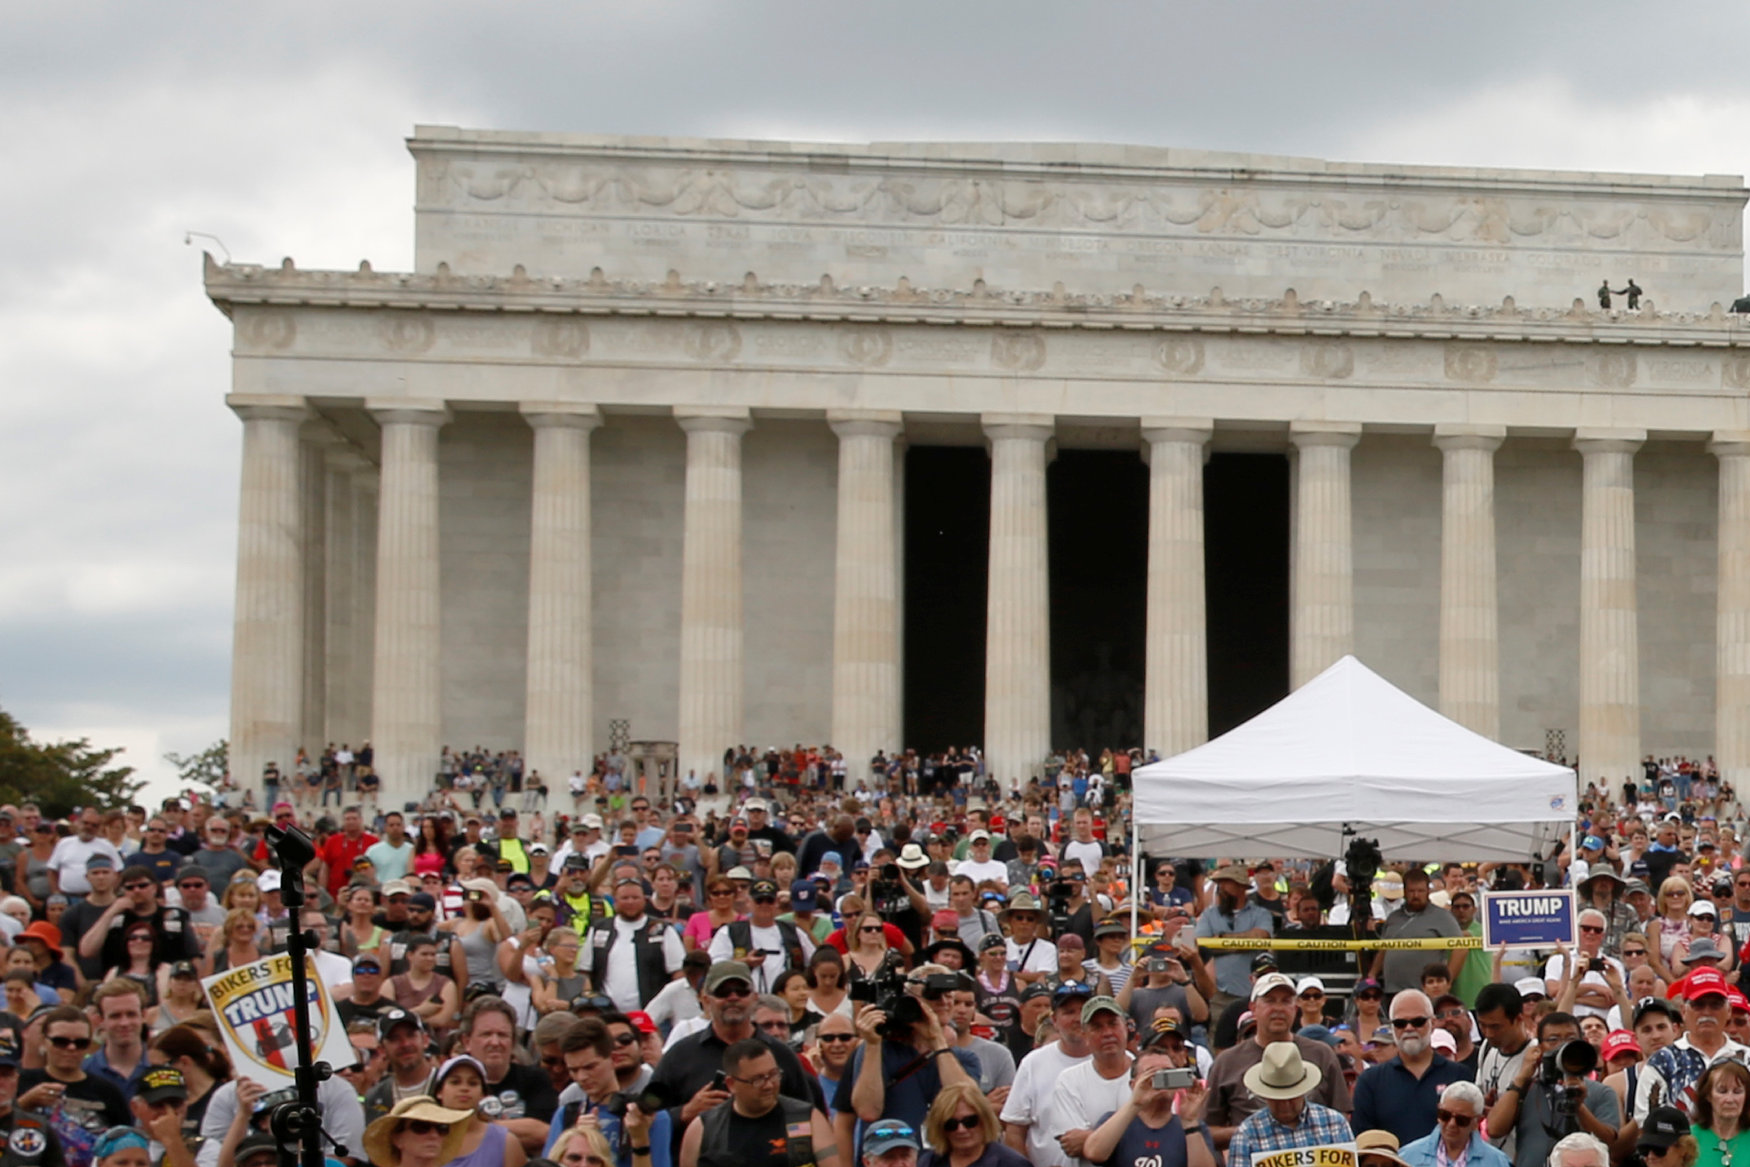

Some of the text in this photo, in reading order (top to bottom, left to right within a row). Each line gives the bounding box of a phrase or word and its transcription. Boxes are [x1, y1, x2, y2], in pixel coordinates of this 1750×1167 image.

[1496, 897, 1563, 917] TRUMP
[1221, 939, 1272, 949] CAUTION
[1297, 939, 1347, 949] CAUTION
[1372, 939, 1422, 949] CAUTION
[208, 962, 272, 1000] BIKERS
[1319, 1149, 1351, 1167] FOR
